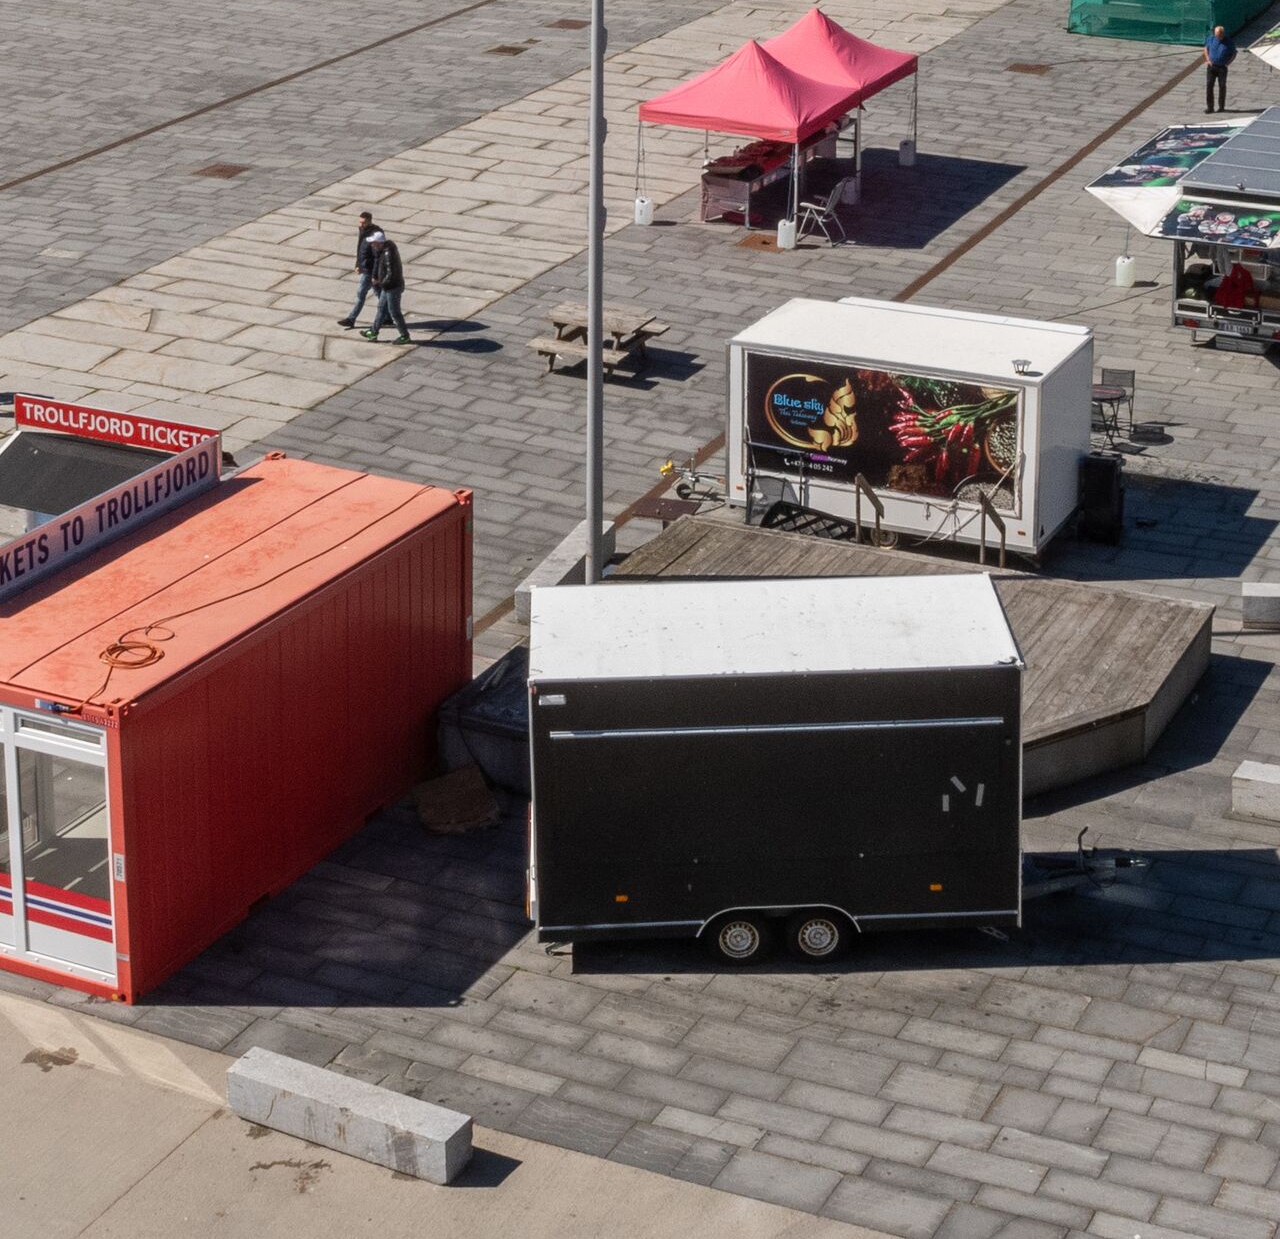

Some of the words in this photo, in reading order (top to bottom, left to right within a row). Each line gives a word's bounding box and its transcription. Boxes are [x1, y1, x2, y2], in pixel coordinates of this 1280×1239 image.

[22, 402, 135, 438] TROLLFJORD
[773, 393, 802, 409] Blue
[803, 398, 825, 416] sky
[60, 514, 85, 553] TO
[95, 449, 210, 534] TROLLFJORD
